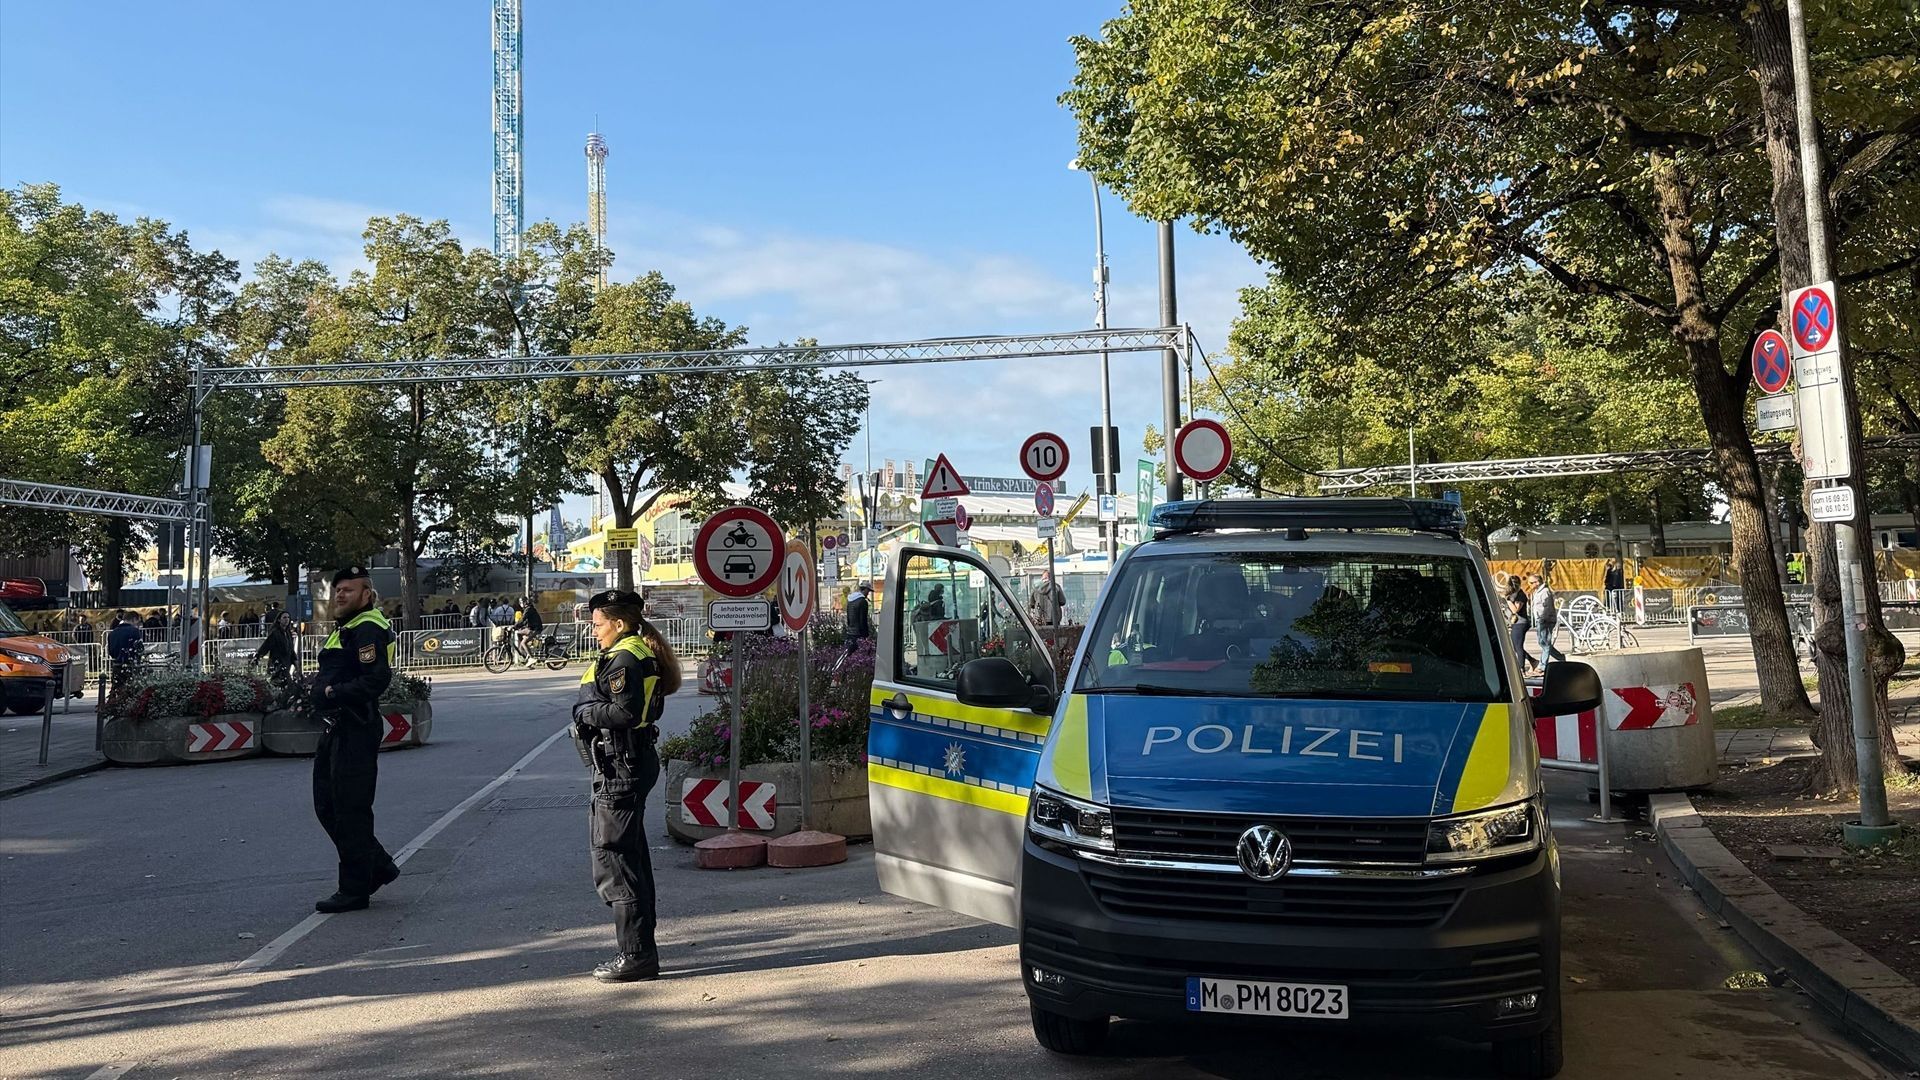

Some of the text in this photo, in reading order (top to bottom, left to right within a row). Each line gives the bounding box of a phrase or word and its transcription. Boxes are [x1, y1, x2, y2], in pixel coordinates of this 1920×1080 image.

[1032, 445, 1057, 469] 10
[974, 478, 1001, 491] trinke
[1141, 724, 1403, 763] POLIZEI
[1276, 986, 1344, 1015] 8023
